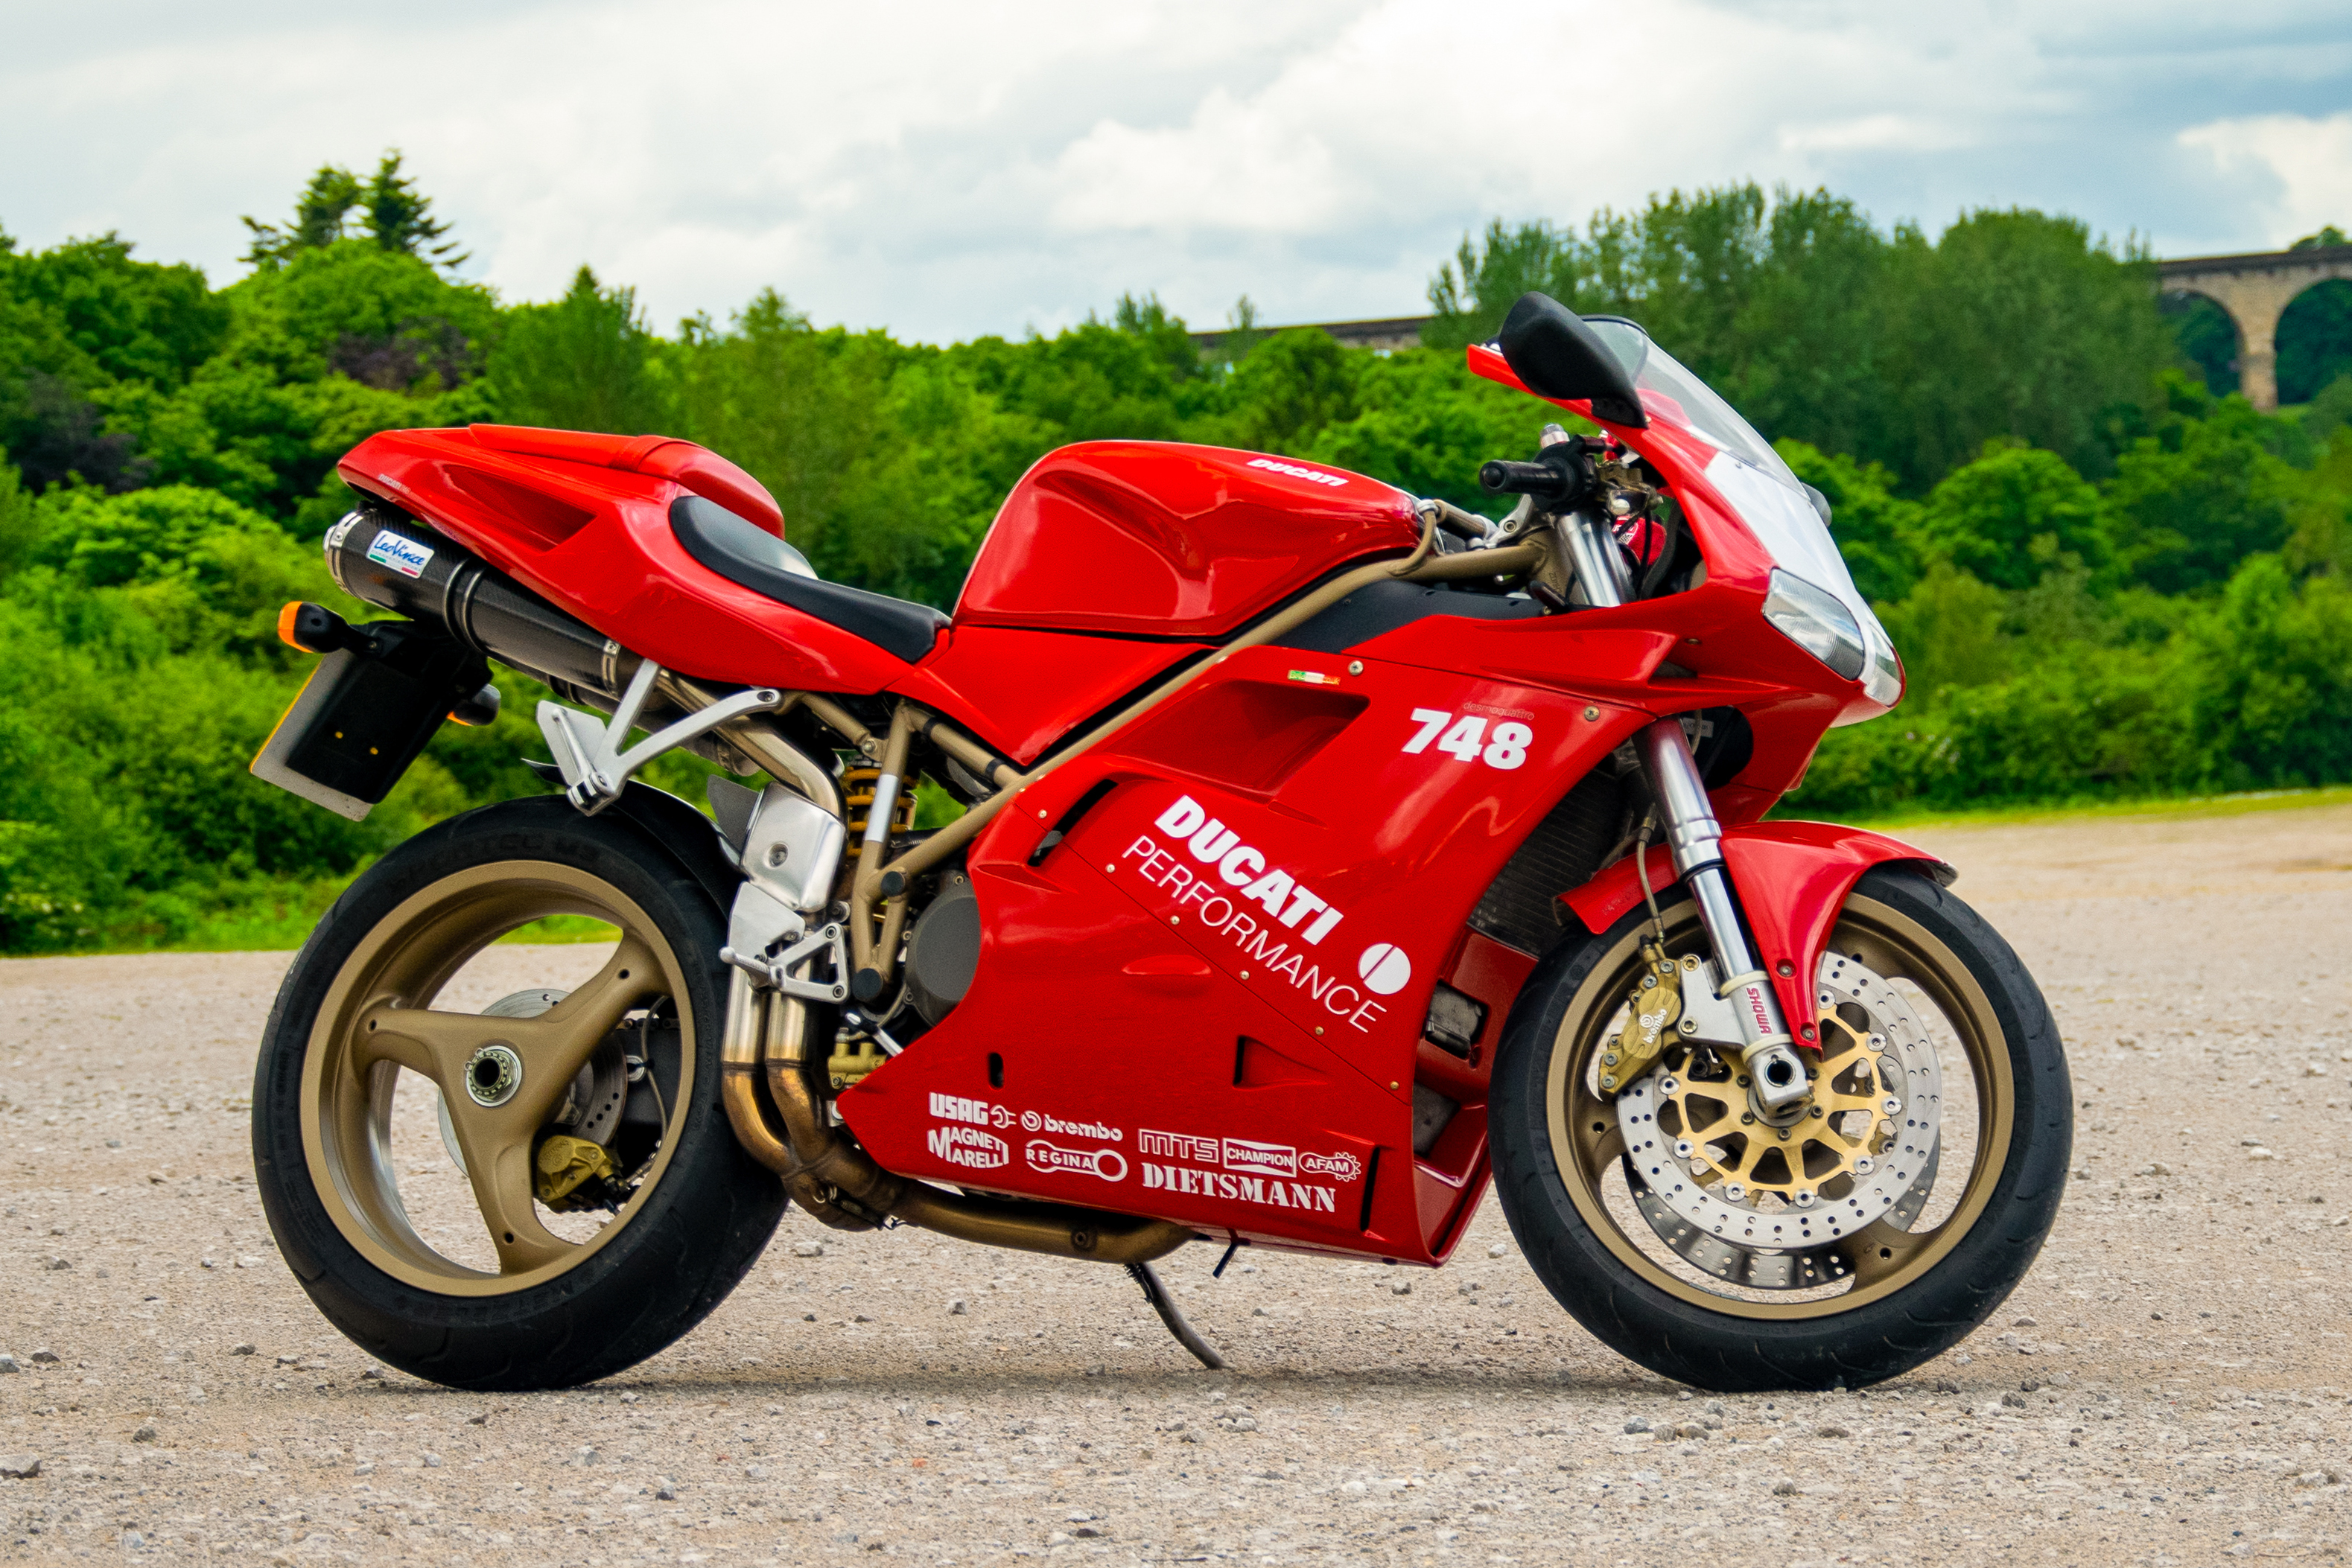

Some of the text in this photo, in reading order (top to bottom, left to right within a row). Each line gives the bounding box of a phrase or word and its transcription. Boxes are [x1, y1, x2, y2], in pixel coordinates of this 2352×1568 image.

[1247, 459, 1349, 486] DUCATI
[374, 534, 425, 565] LeoVince
[1463, 701, 1535, 721] desmoquattro
[1402, 708, 1533, 769] 748
[1154, 794, 1344, 945] DUCATI
[1122, 835, 1387, 1033] PERFORMANCE
[1642, 1009, 1667, 1044] brembo
[1746, 987, 1773, 1034] SHOWA
[929, 1091, 988, 1125] USAG
[928, 1126, 1008, 1159] MAGNETI
[1044, 1114, 1122, 1141] brembo
[929, 1145, 1009, 1168] MARELLI
[1026, 1147, 1094, 1170] REGINA
[1139, 1128, 1218, 1164] MTS
[1227, 1147, 1293, 1167] CHAMPION
[1306, 1157, 1349, 1173] AFAM
[1141, 1162, 1335, 1213] DIETSMANN
